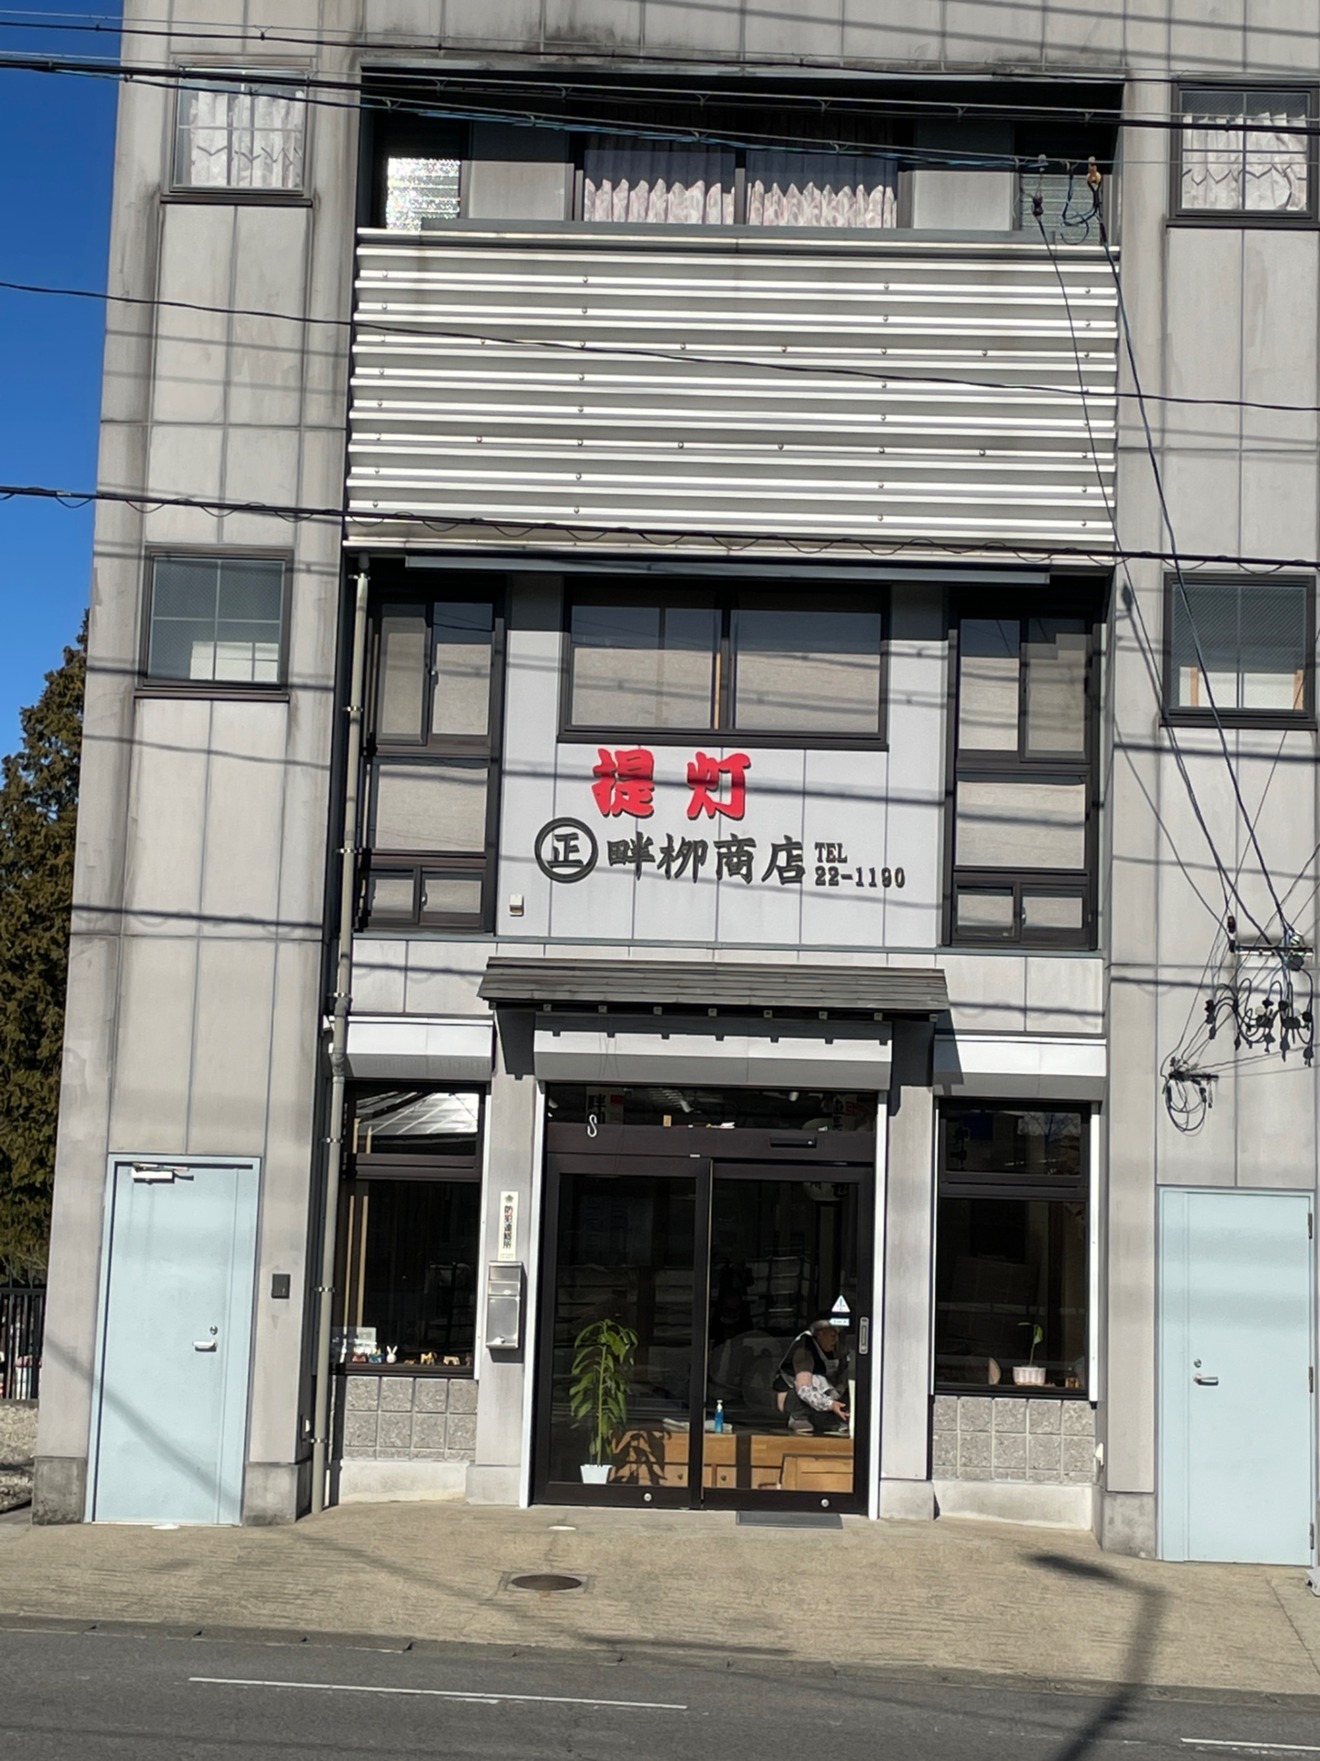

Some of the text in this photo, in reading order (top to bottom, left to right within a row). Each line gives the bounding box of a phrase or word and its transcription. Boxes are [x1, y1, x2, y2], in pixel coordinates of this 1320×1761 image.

[591, 747, 752, 821] 提灯
[607, 831, 806, 885] 畔柳商店
[814, 842, 848, 864] TEL
